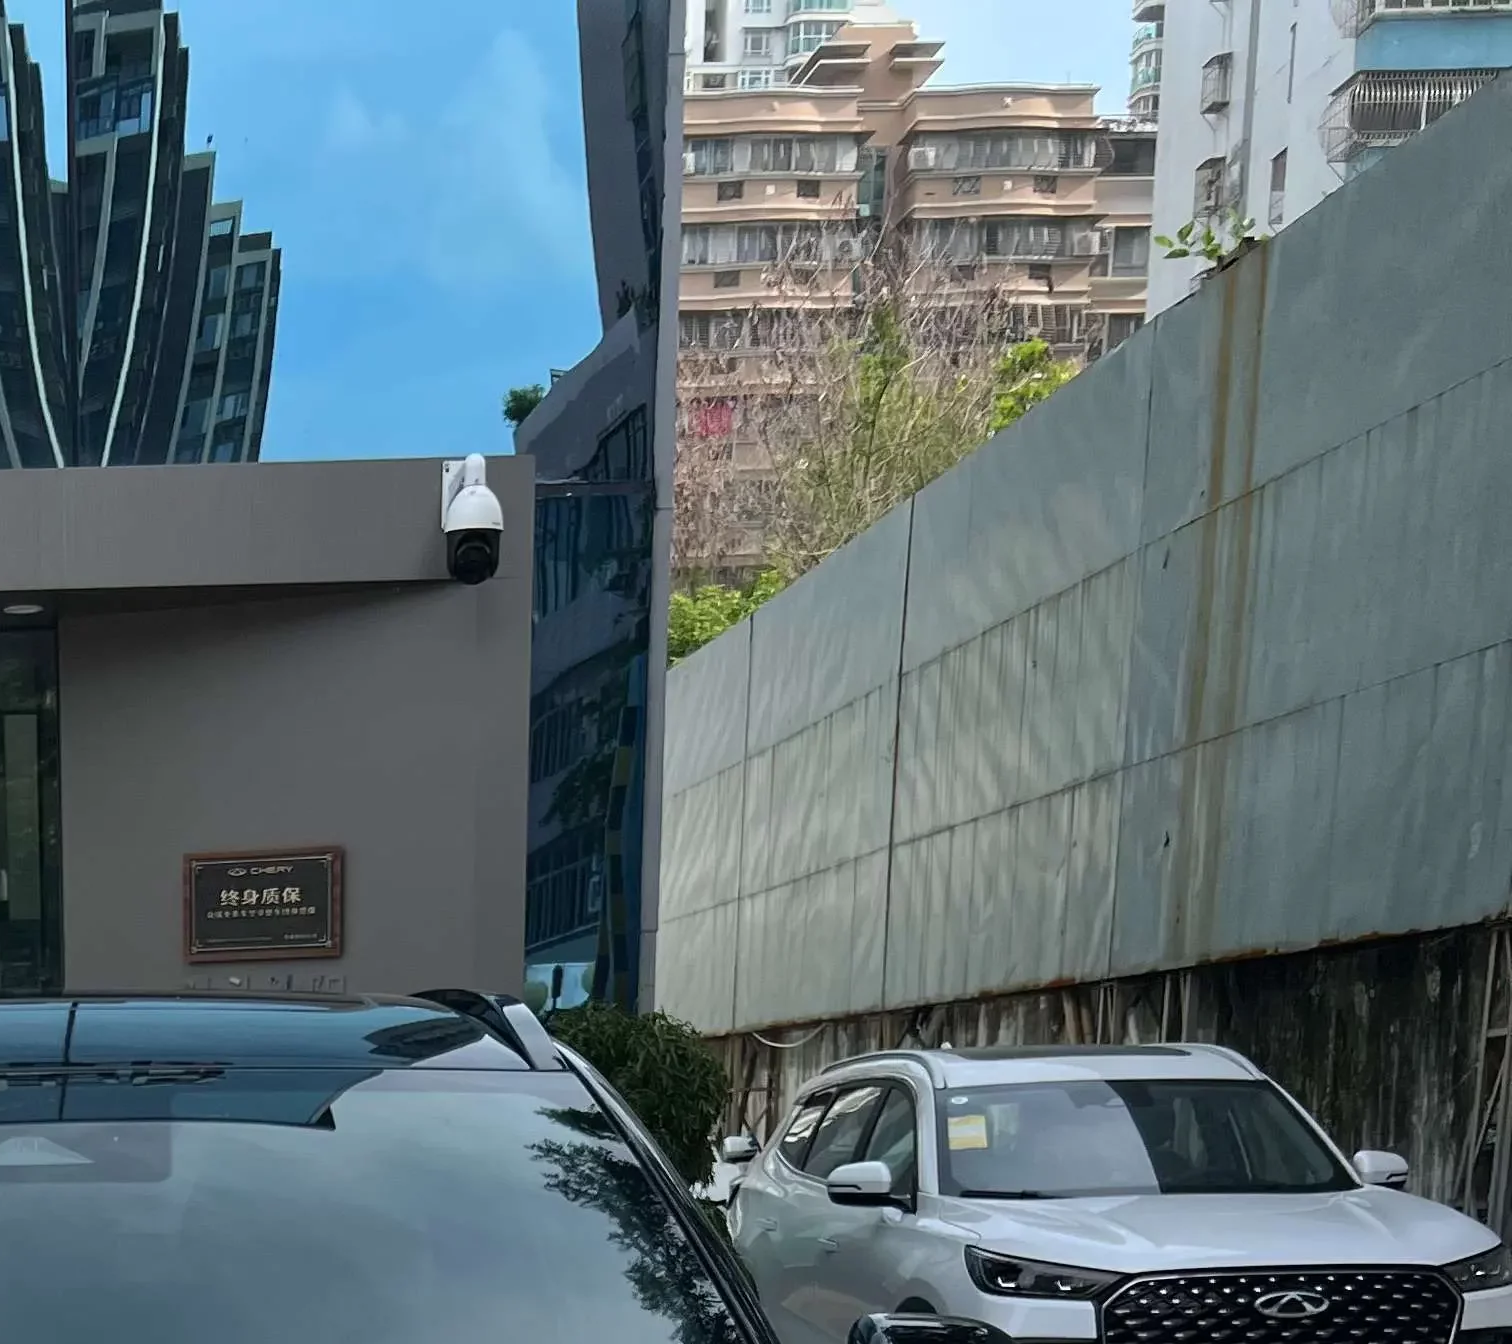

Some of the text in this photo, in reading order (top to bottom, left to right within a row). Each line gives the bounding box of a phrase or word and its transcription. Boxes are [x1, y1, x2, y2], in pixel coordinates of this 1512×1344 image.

[250, 865, 294, 875] CHERY
[219, 886, 302, 906] 终身质保
